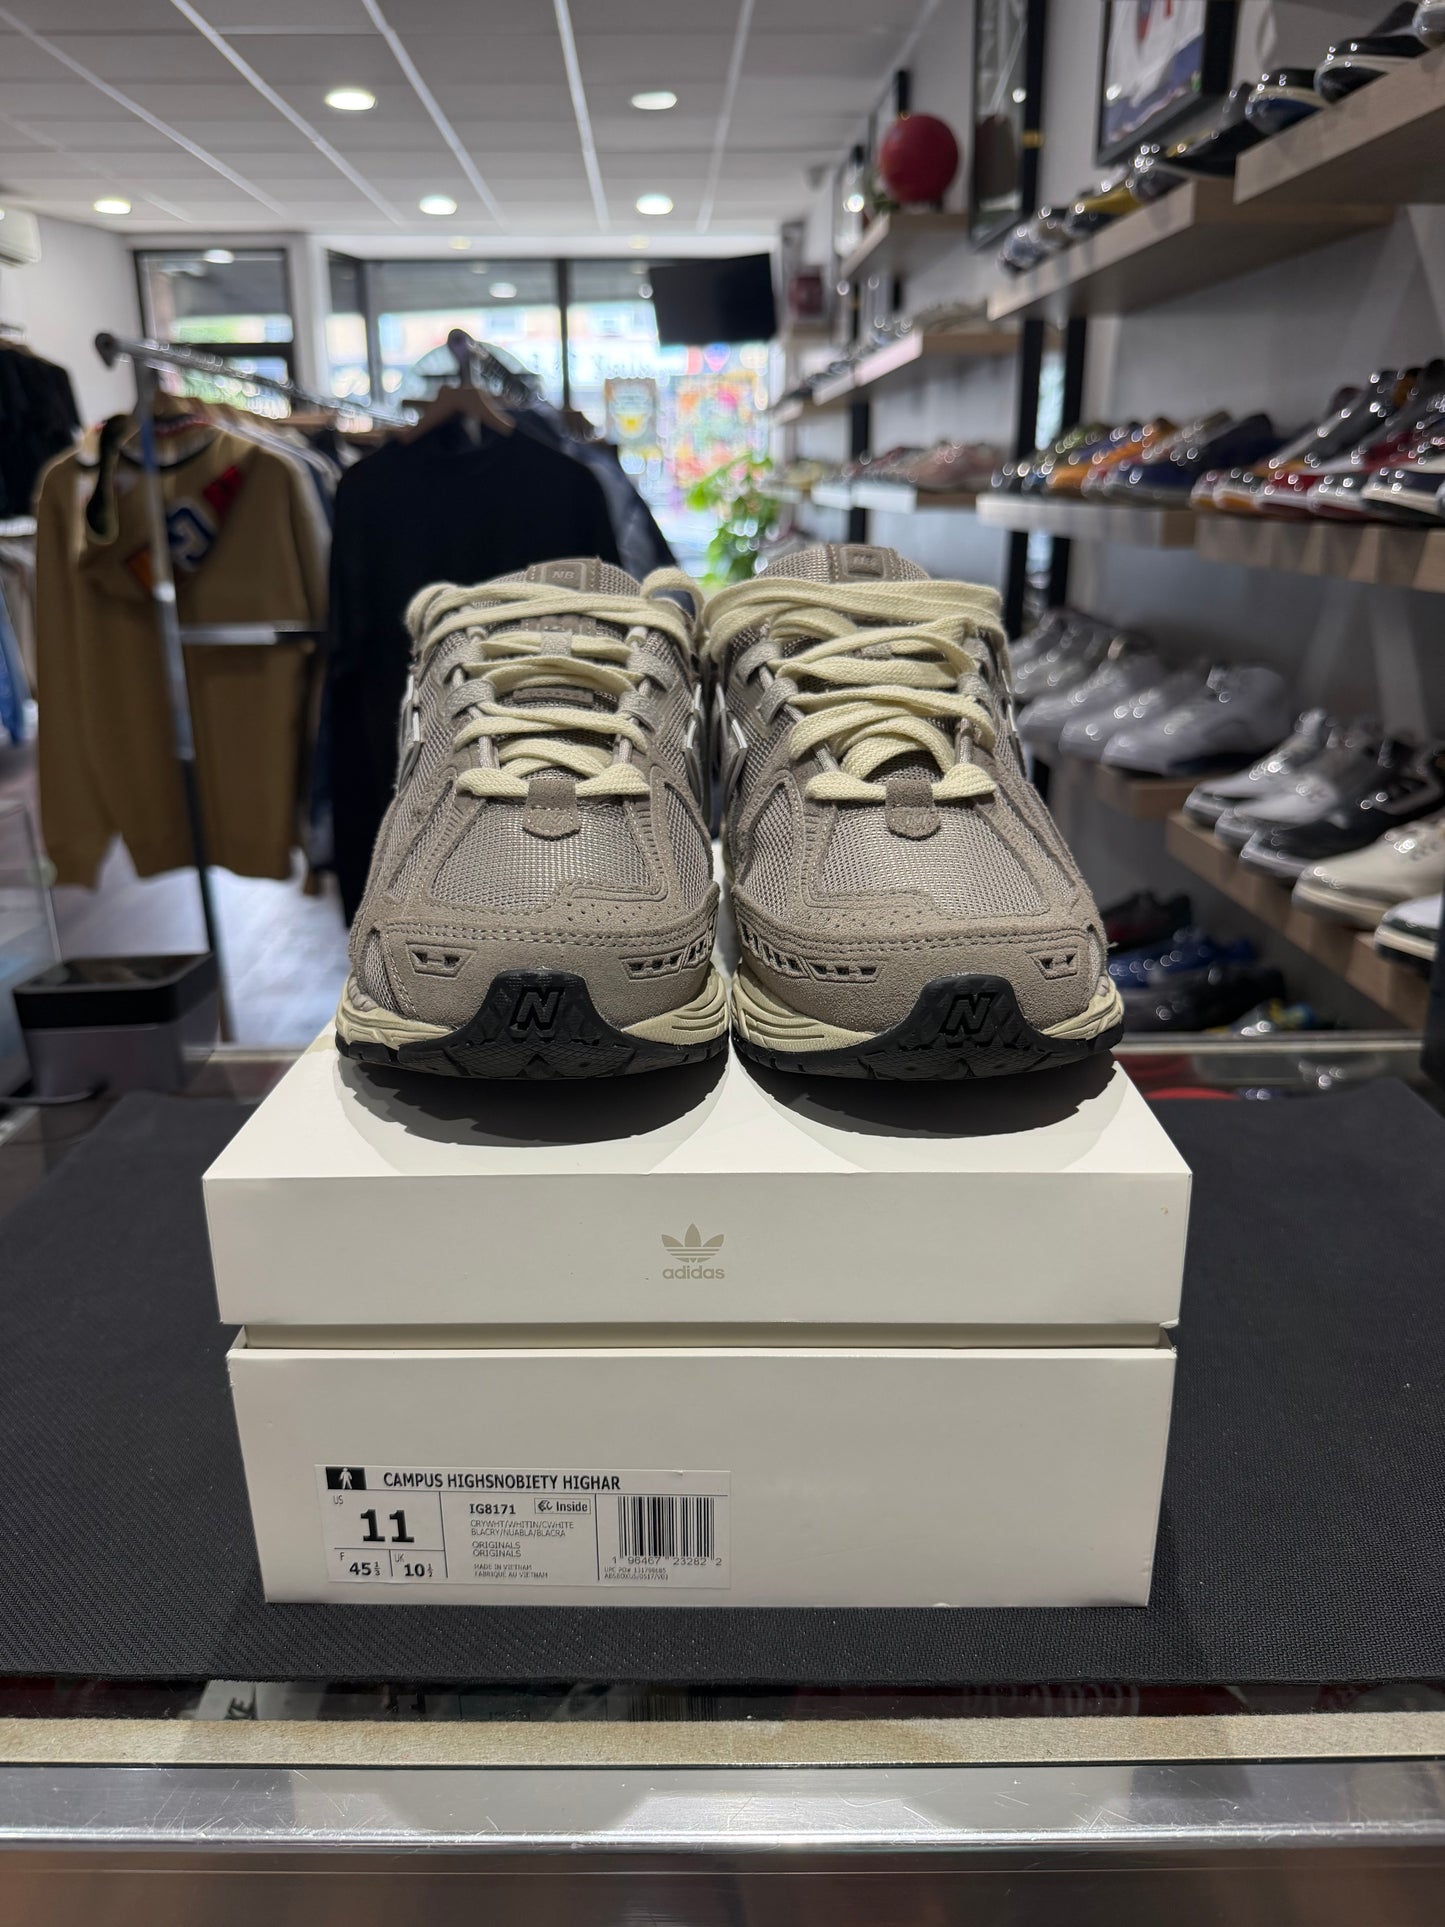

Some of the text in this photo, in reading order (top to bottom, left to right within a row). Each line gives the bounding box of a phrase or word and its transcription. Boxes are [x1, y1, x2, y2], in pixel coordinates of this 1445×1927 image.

[662, 1265, 725, 1280] adidas
[383, 1472, 621, 1490] CAMPUS HIGHSNOBIETY HIGHAR
[333, 1495, 344, 1505] US
[469, 1503, 516, 1515] IG8171
[556, 1501, 588, 1512] Inside
[360, 1508, 415, 1544] 11
[472, 1541, 521, 1550] ORIGINALS
[394, 1553, 405, 1563] UK
[473, 1549, 522, 1558] ORIGINALS
[612, 1556, 722, 1566] 1 96467 23282 2
